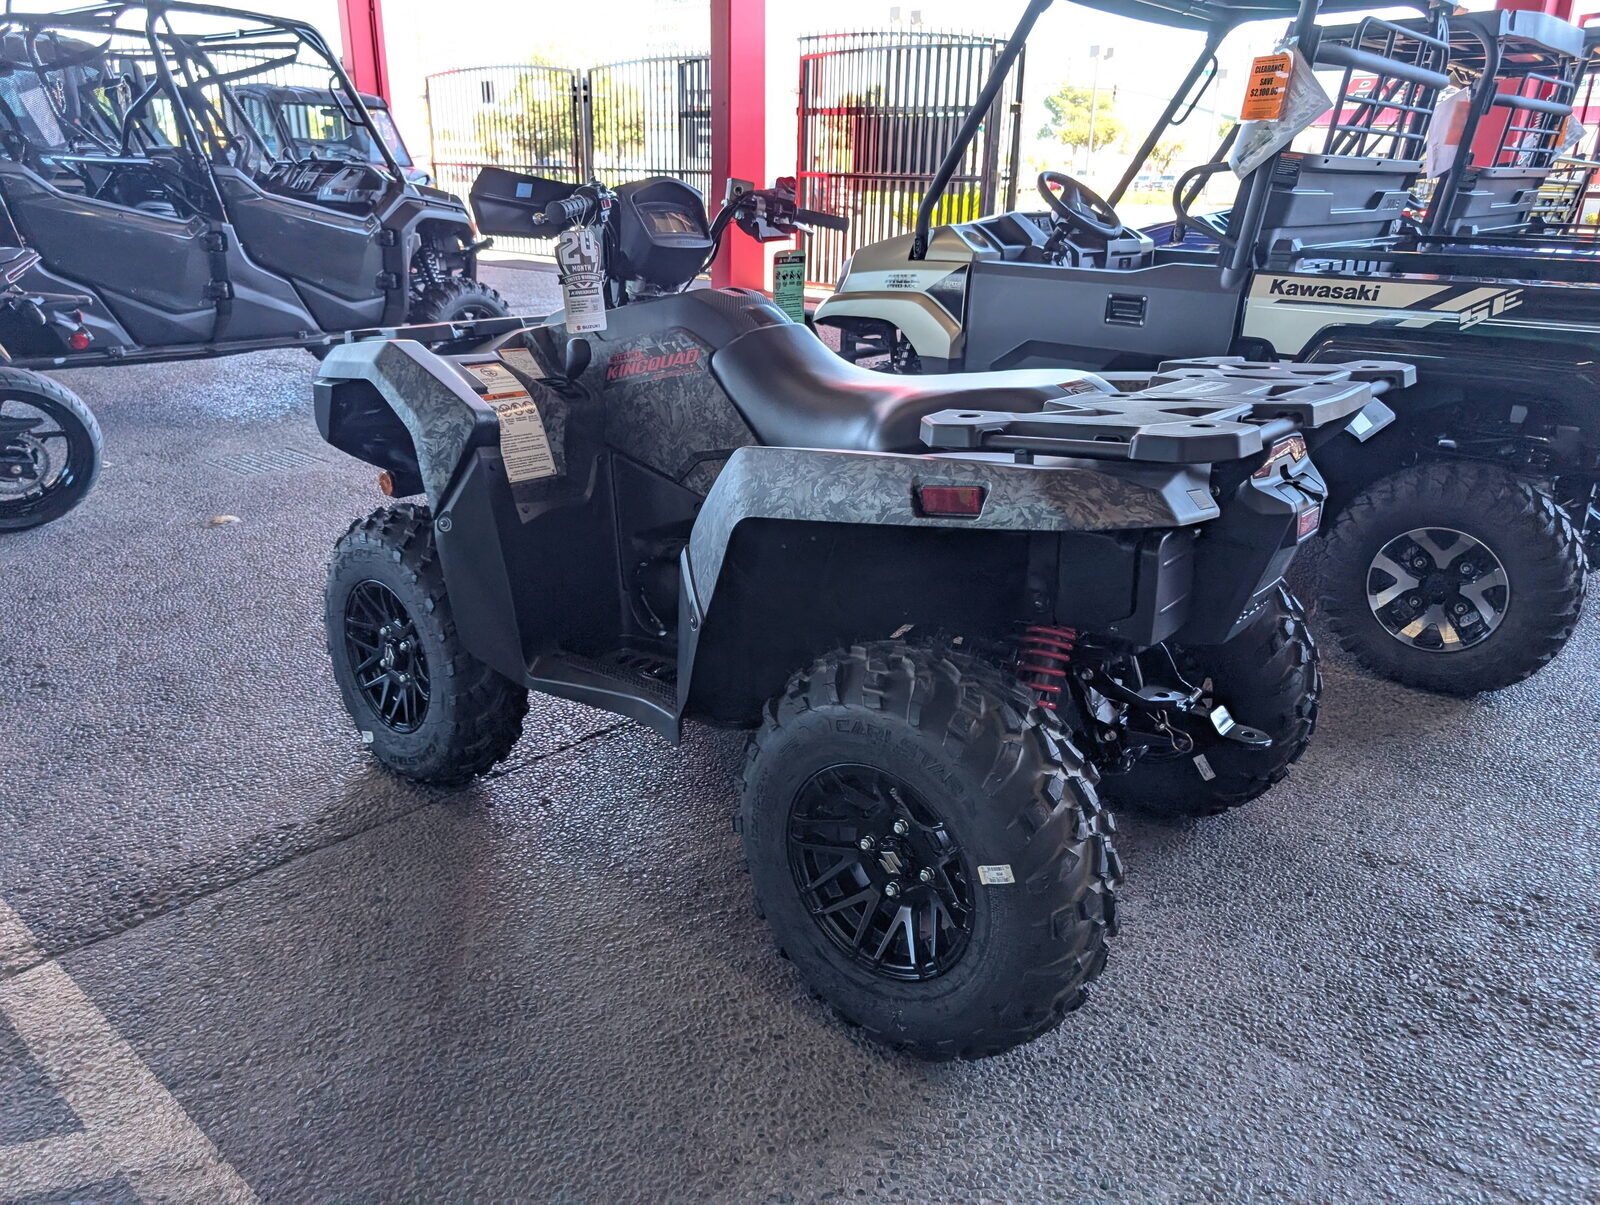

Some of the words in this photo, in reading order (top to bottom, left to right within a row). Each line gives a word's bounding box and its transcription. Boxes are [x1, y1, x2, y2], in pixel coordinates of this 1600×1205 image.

[1255, 63, 1285, 74] CLEARANCE
[1260, 77, 1274, 86] SAVE
[560, 229, 597, 265] 24
[571, 264, 592, 272] MONTH
[565, 275, 581, 284] LIMITED
[1269, 279, 1381, 301] Kawasaki
[606, 348, 699, 380] KINGQUAD
